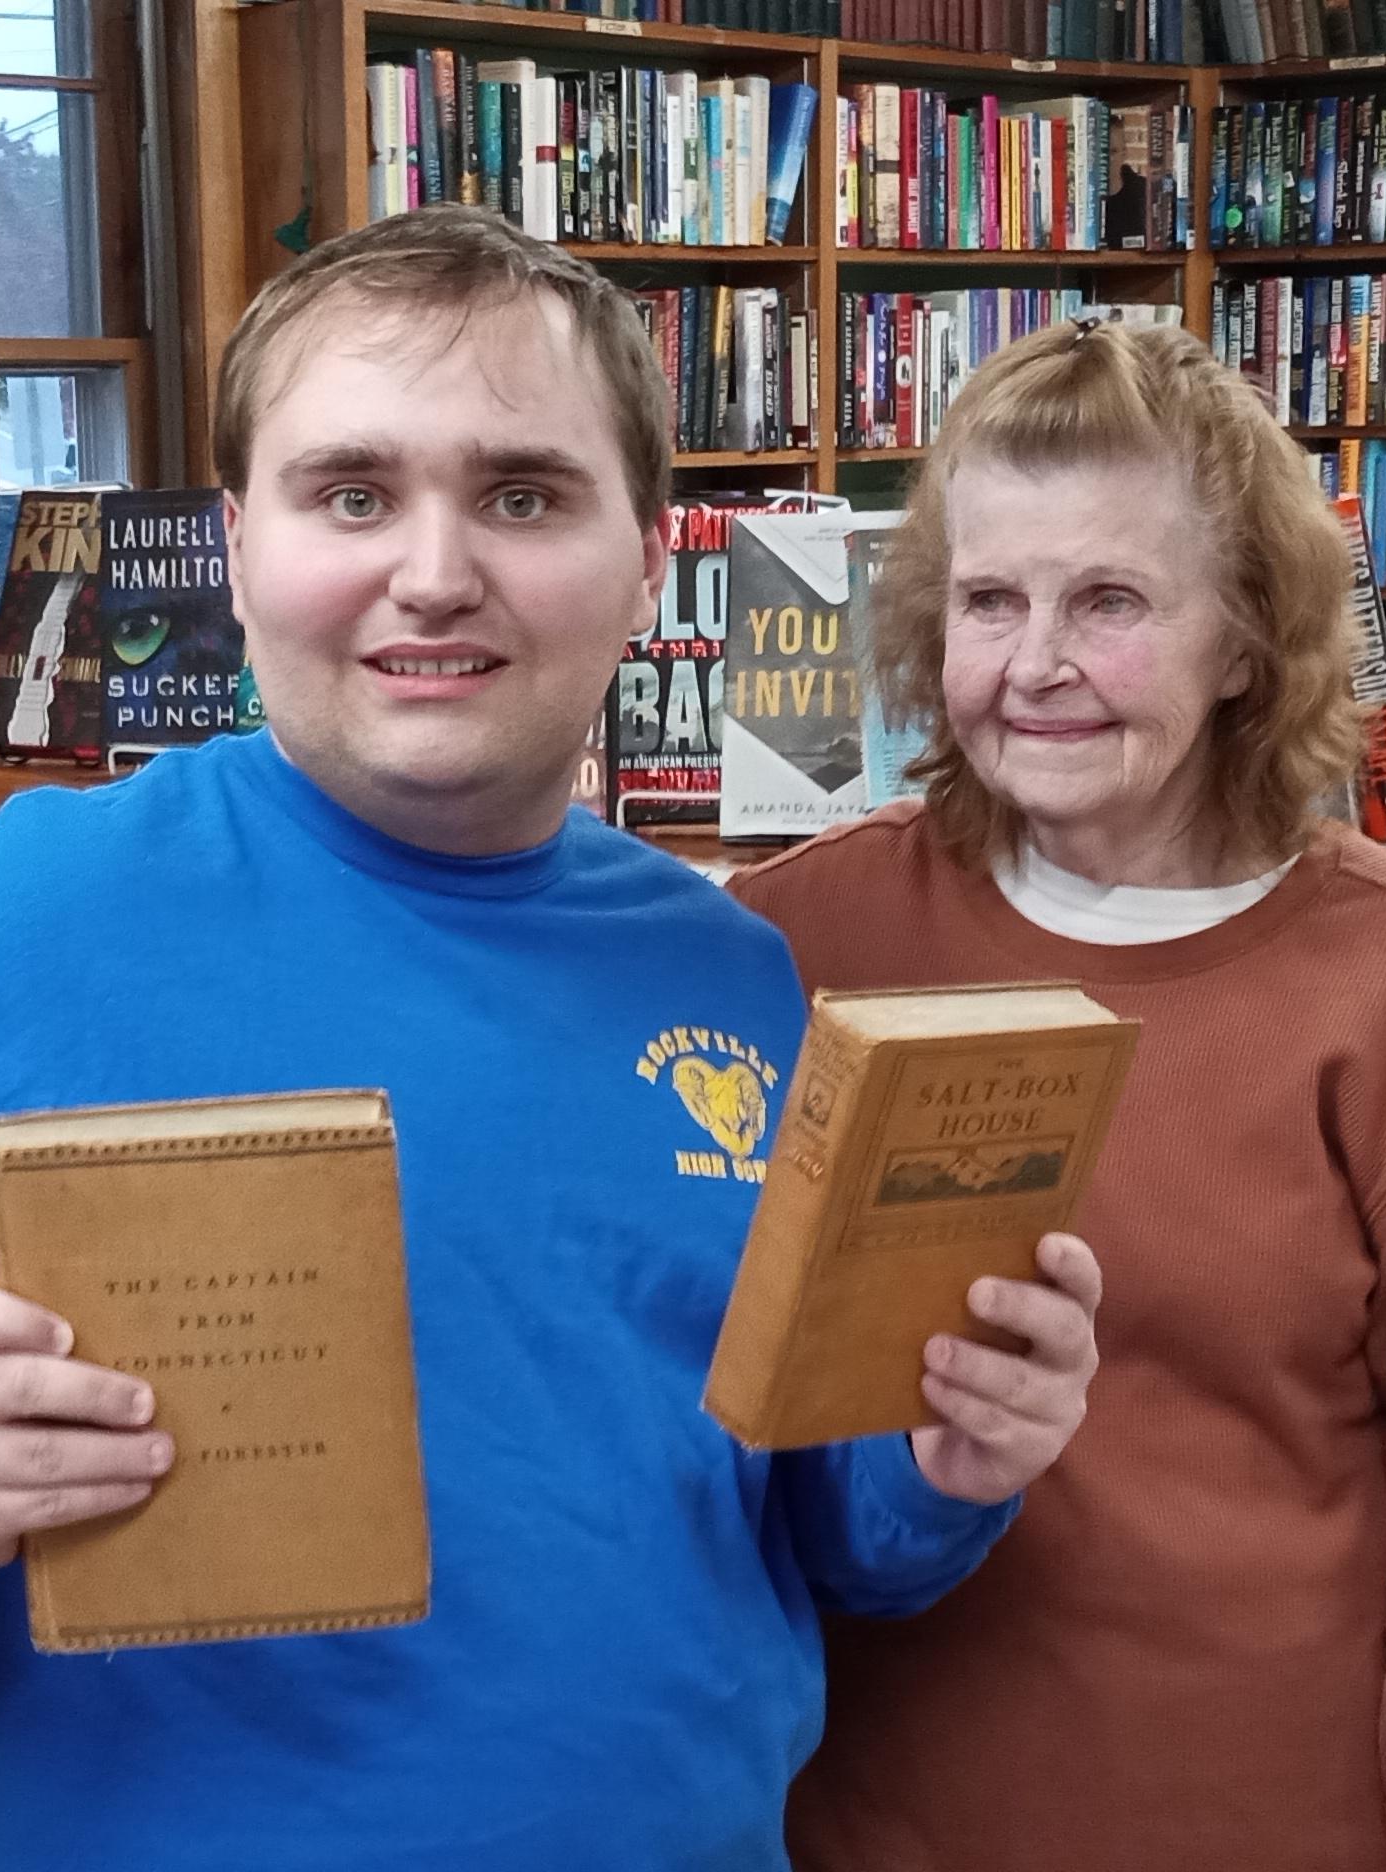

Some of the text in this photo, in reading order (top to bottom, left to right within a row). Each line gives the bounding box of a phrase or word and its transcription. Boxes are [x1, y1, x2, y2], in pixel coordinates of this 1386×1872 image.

[1334, 161, 1348, 228] Shrink Rap
[1368, 281, 1382, 382] JAMES PATTERSON
[109, 516, 215, 551] LAURELL
[111, 556, 223, 590] HAMILTO
[749, 607, 839, 655] YOU
[117, 706, 235, 728] PUNCH
[619, 754, 682, 769] AN AMERICAN
[741, 803, 816, 815] AMANDA
[636, 1025, 778, 1090] ROCKVILLE
[937, 1108, 1045, 1138] HOUSE
[675, 1149, 727, 1179] HIGH
[105, 1267, 319, 1295] THE CAPTAIN
[179, 1312, 255, 1330] FROM
[113, 1344, 327, 1372] CONNECTICUT
[201, 1441, 326, 1461] FORESTER
